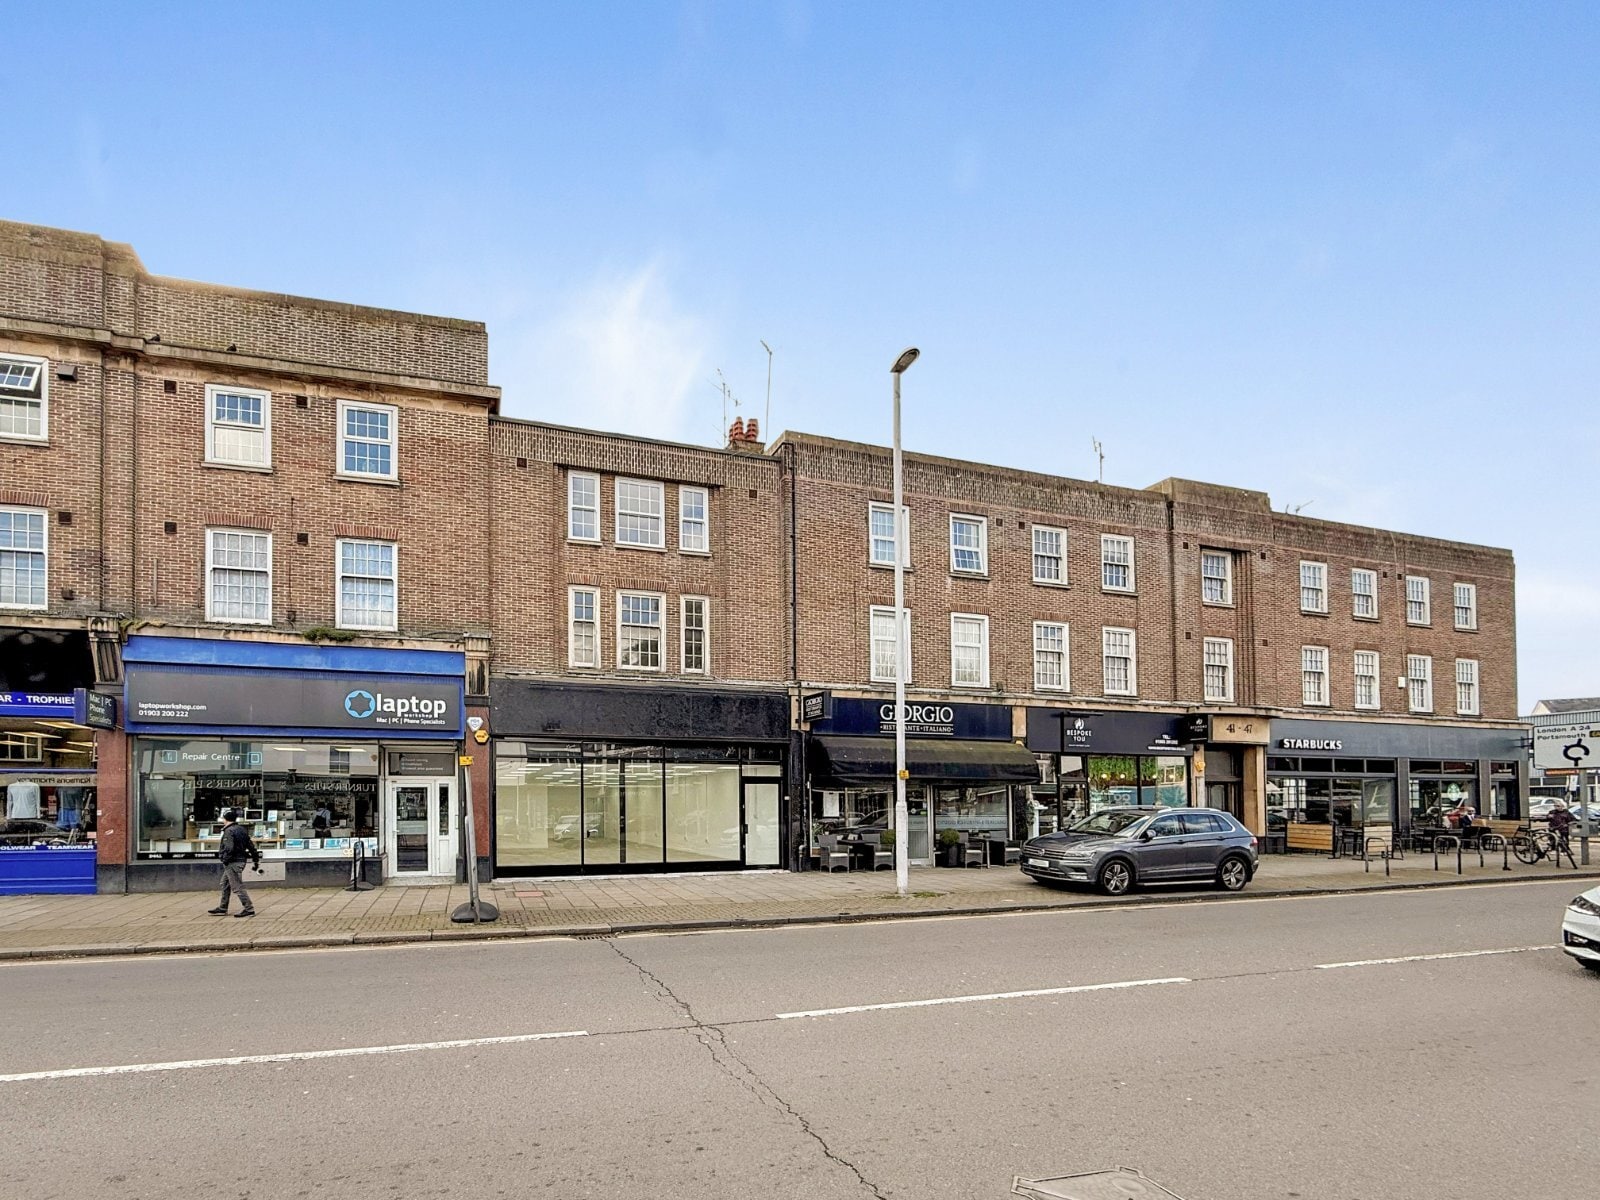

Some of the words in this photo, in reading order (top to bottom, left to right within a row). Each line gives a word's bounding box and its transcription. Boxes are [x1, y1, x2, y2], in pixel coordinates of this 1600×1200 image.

[138, 702, 207, 711] laptopworkshop.com
[376, 693, 446, 718] laptop
[883, 724, 920, 732] RISTANTE
[1244, 724, 1253, 733] 47
[1066, 729, 1092, 737] BESPOKE
[1283, 738, 1342, 750] STARBUCKS
[182, 752, 208, 762] Repair
[211, 753, 240, 761] Centre
